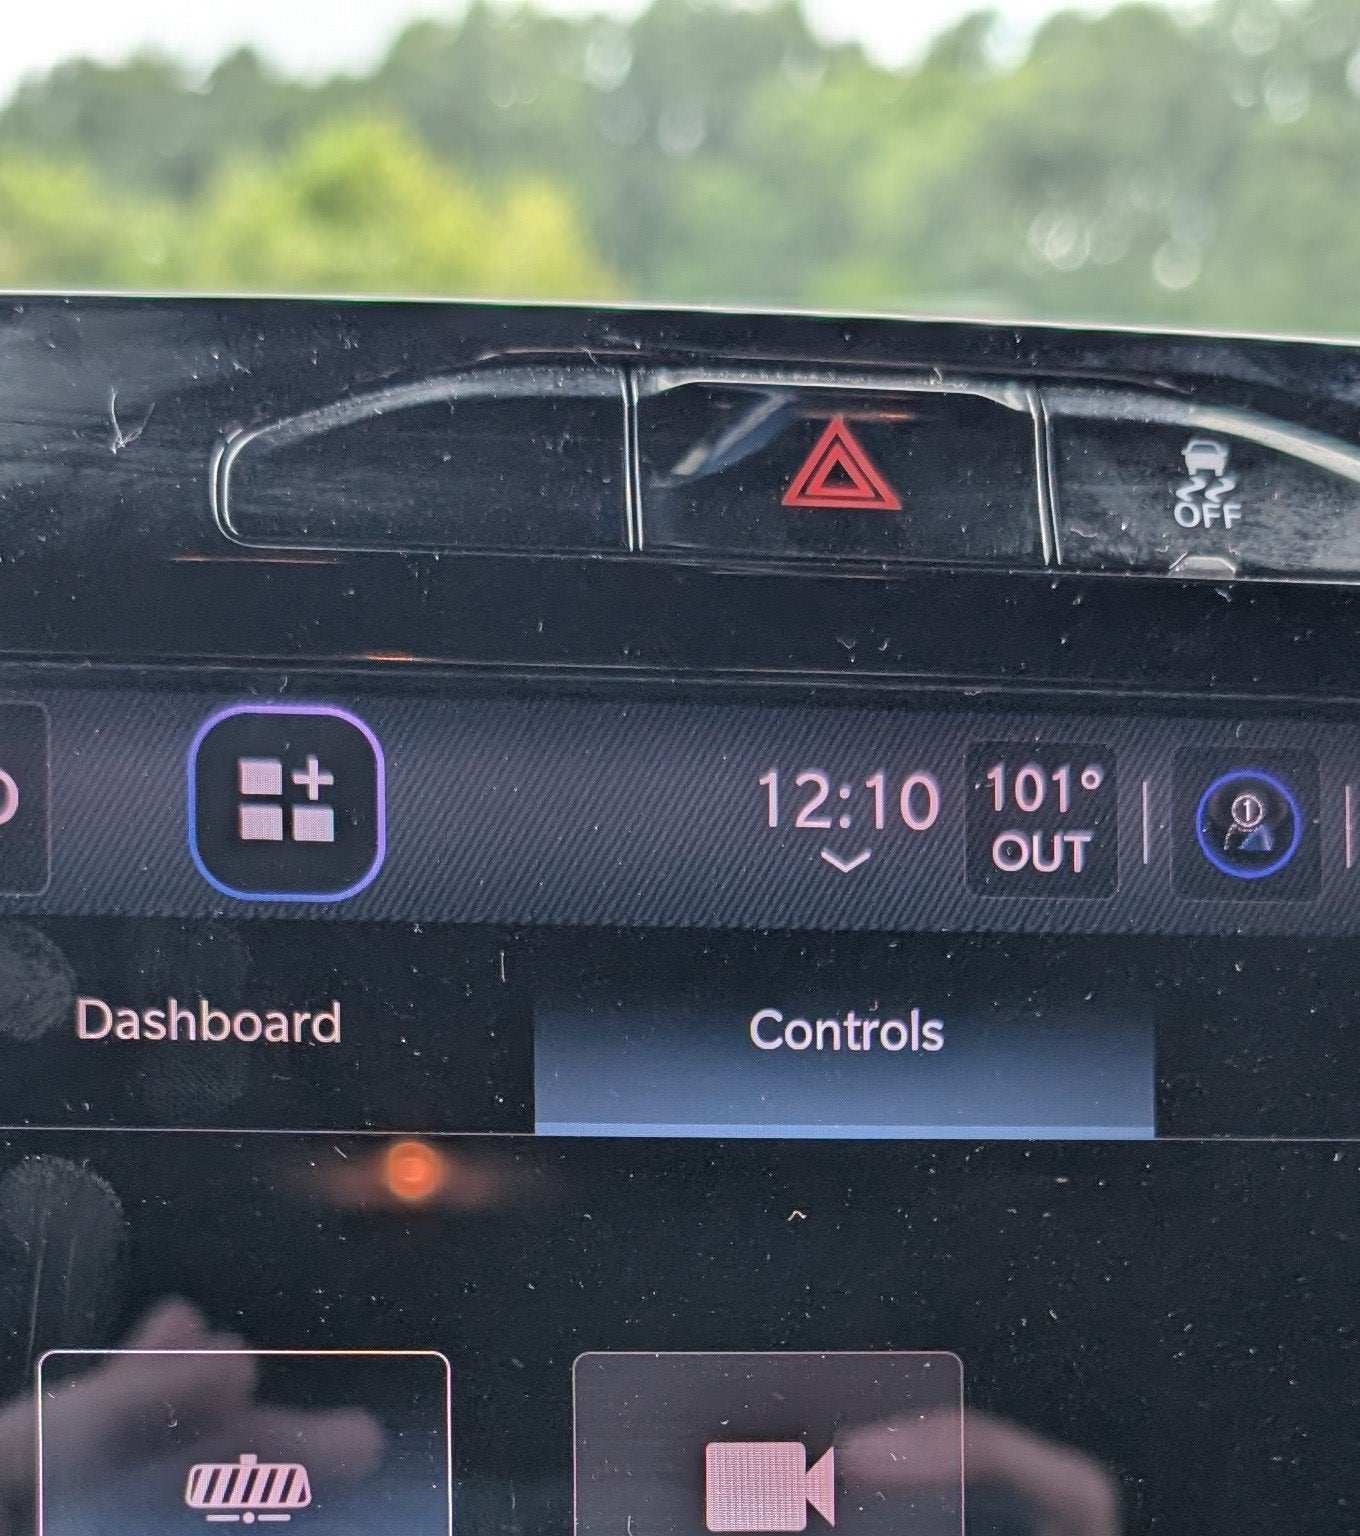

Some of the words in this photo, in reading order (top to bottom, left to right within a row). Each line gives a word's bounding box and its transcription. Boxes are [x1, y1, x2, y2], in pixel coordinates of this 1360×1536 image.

[1174, 502, 1242, 529] OFF
[758, 770, 940, 832] 12:10
[991, 832, 1093, 874] OUT
[75, 1000, 342, 1044] Dashboard
[749, 1010, 945, 1053] Controls
